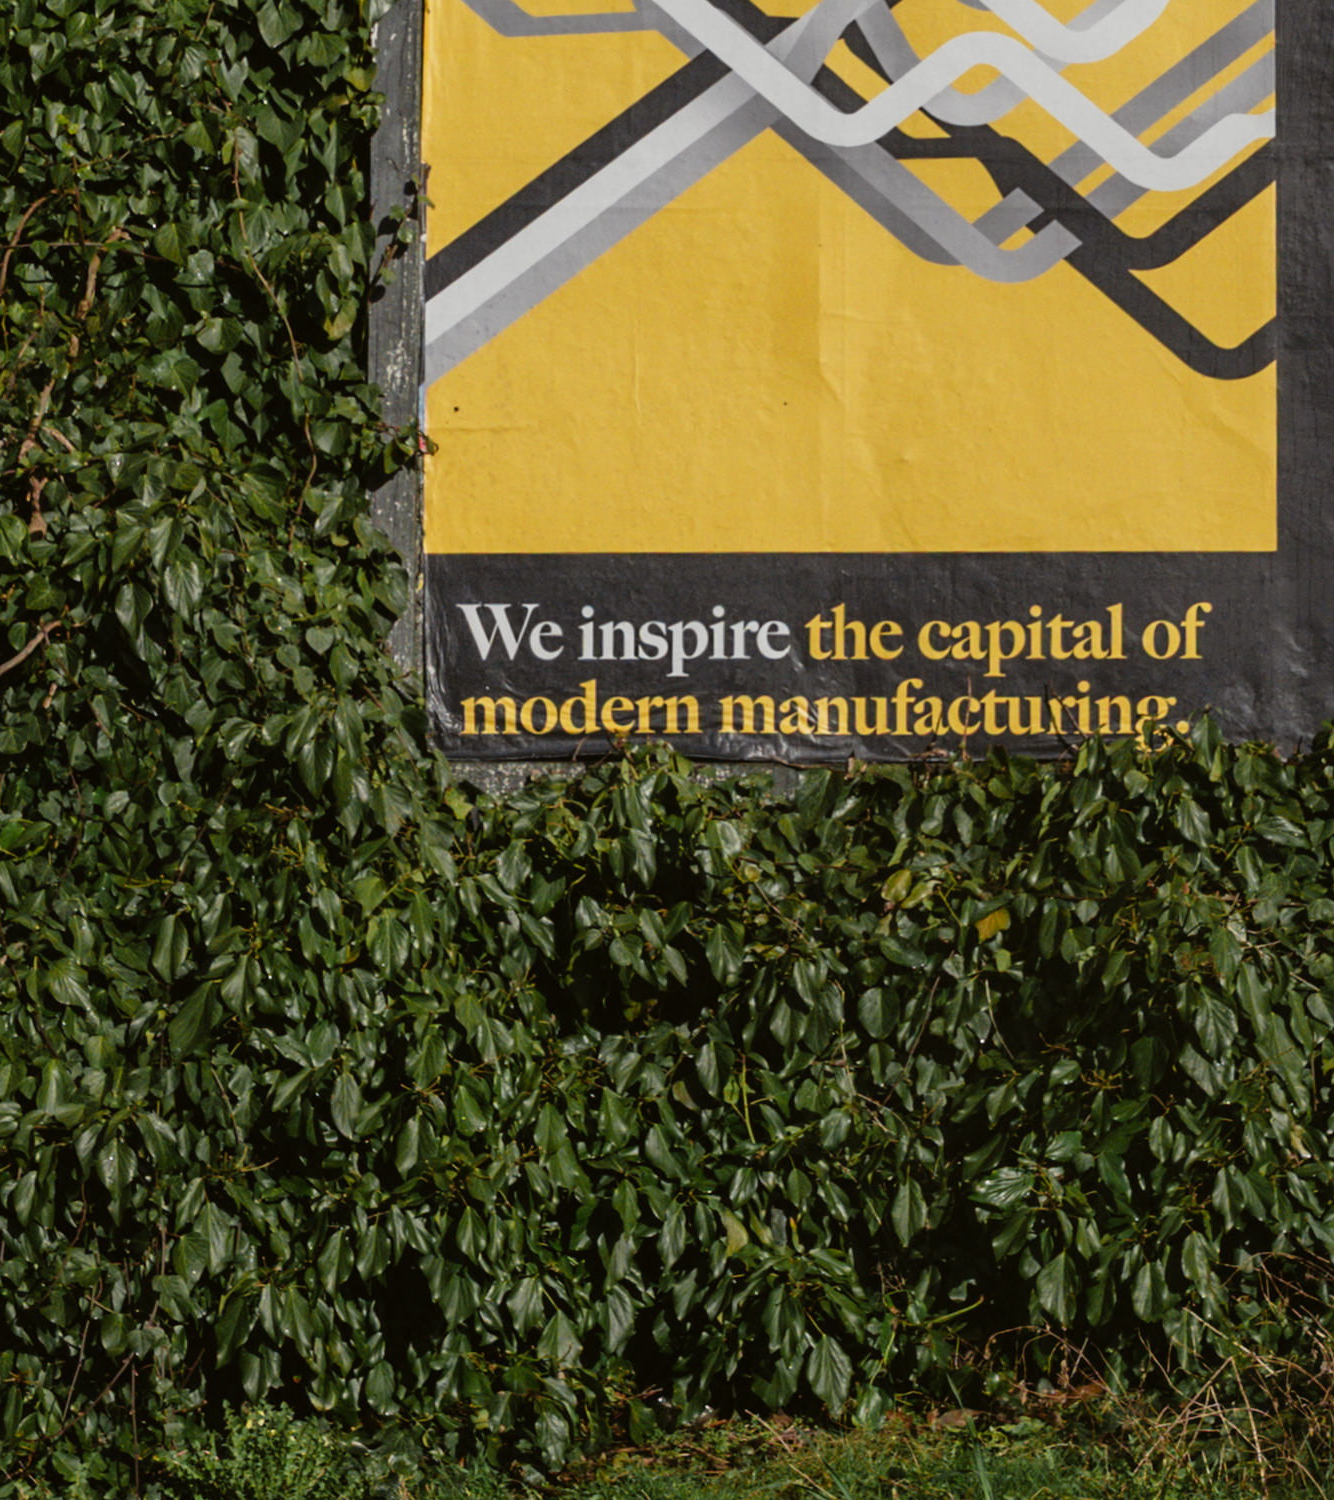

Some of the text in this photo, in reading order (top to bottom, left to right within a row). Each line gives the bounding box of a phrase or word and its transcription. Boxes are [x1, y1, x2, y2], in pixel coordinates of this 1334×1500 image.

[456, 602, 1213, 678] We inspire the capital of
[460, 678, 1190, 754] modern manufacturing.
